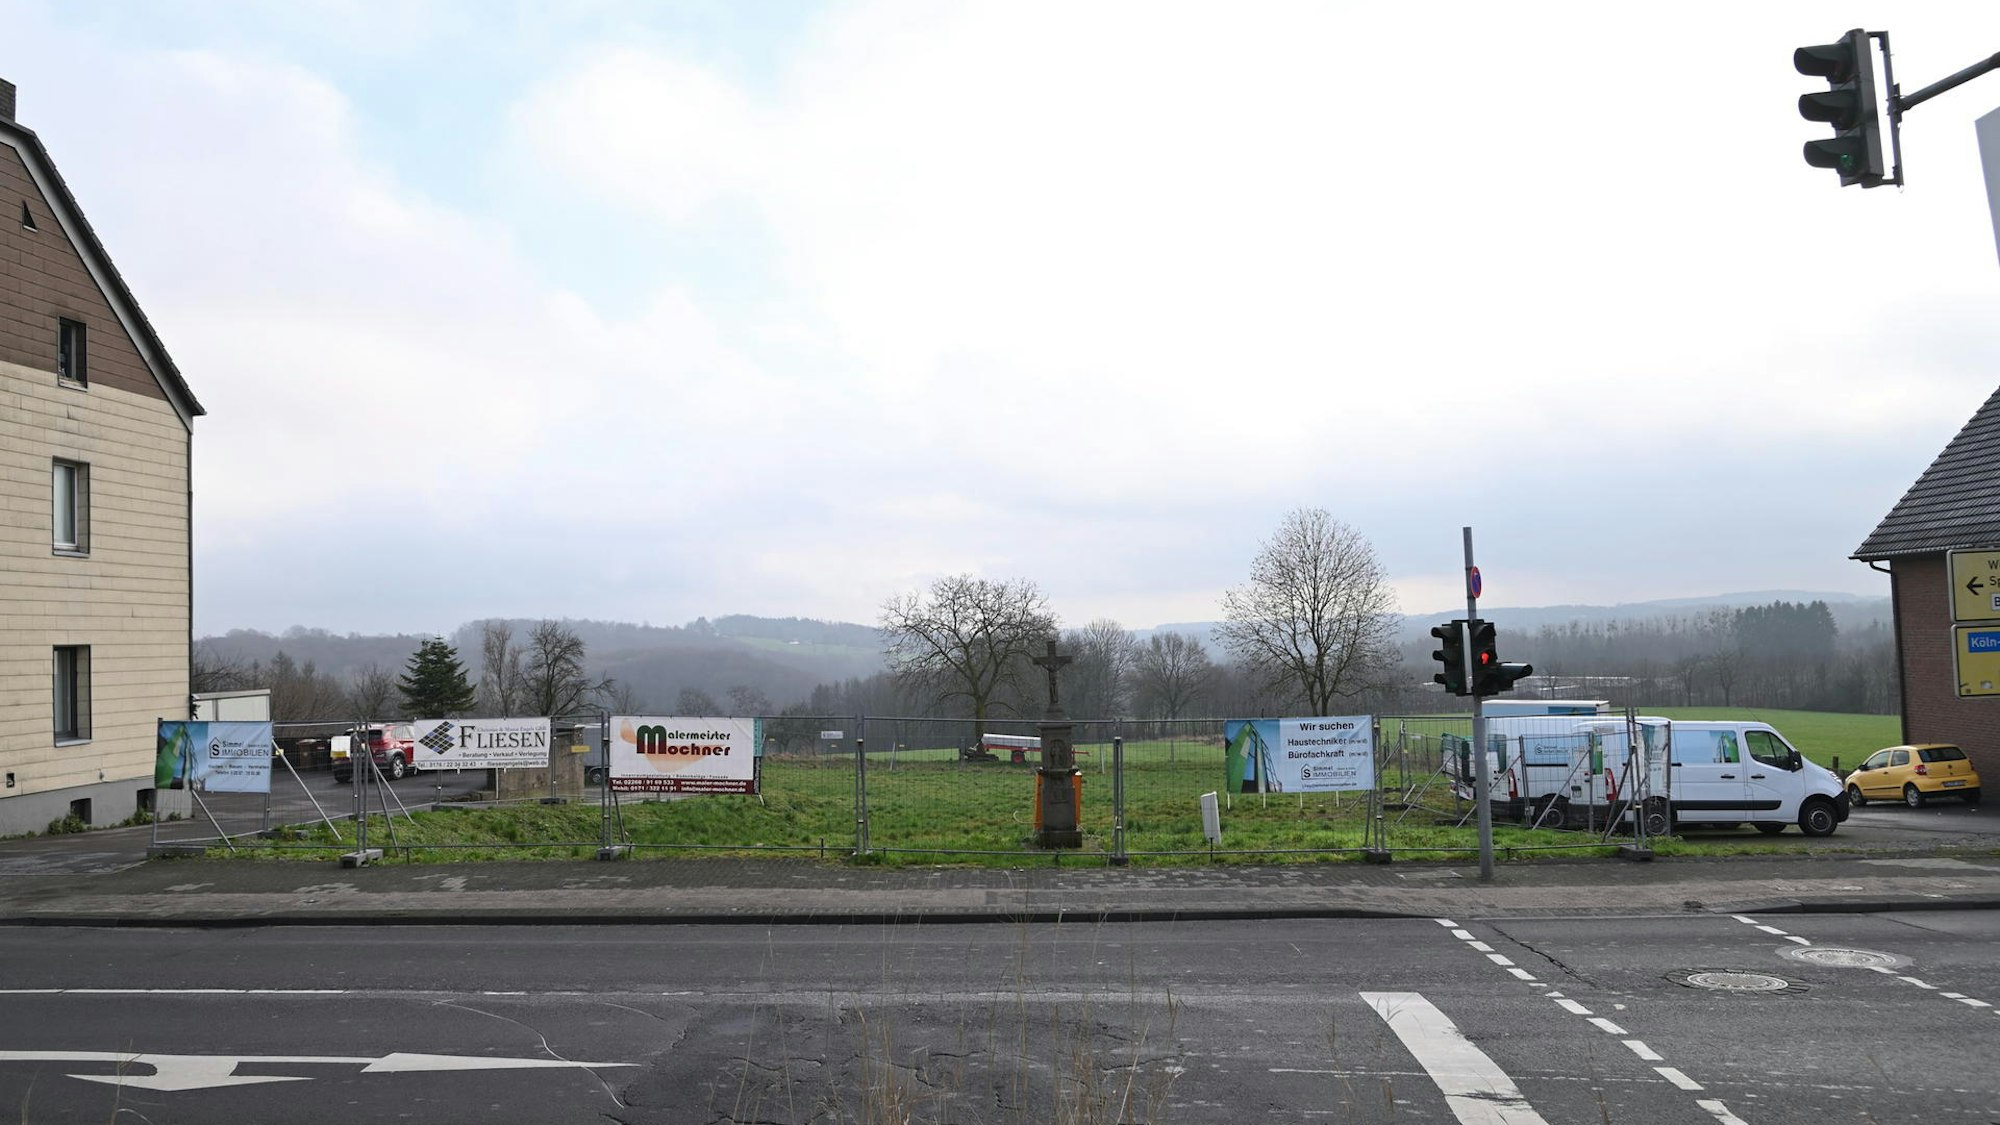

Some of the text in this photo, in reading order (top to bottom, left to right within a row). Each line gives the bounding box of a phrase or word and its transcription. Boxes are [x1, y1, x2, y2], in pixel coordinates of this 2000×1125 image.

[1300, 721, 1355, 731] Wir suchen
[460, 725, 546, 749] FLIESEN
[1287, 738, 1346, 746] Haustechniker
[462, 752, 488, 760] Beratung
[1288, 749, 1345, 759] Bürofachkraft
